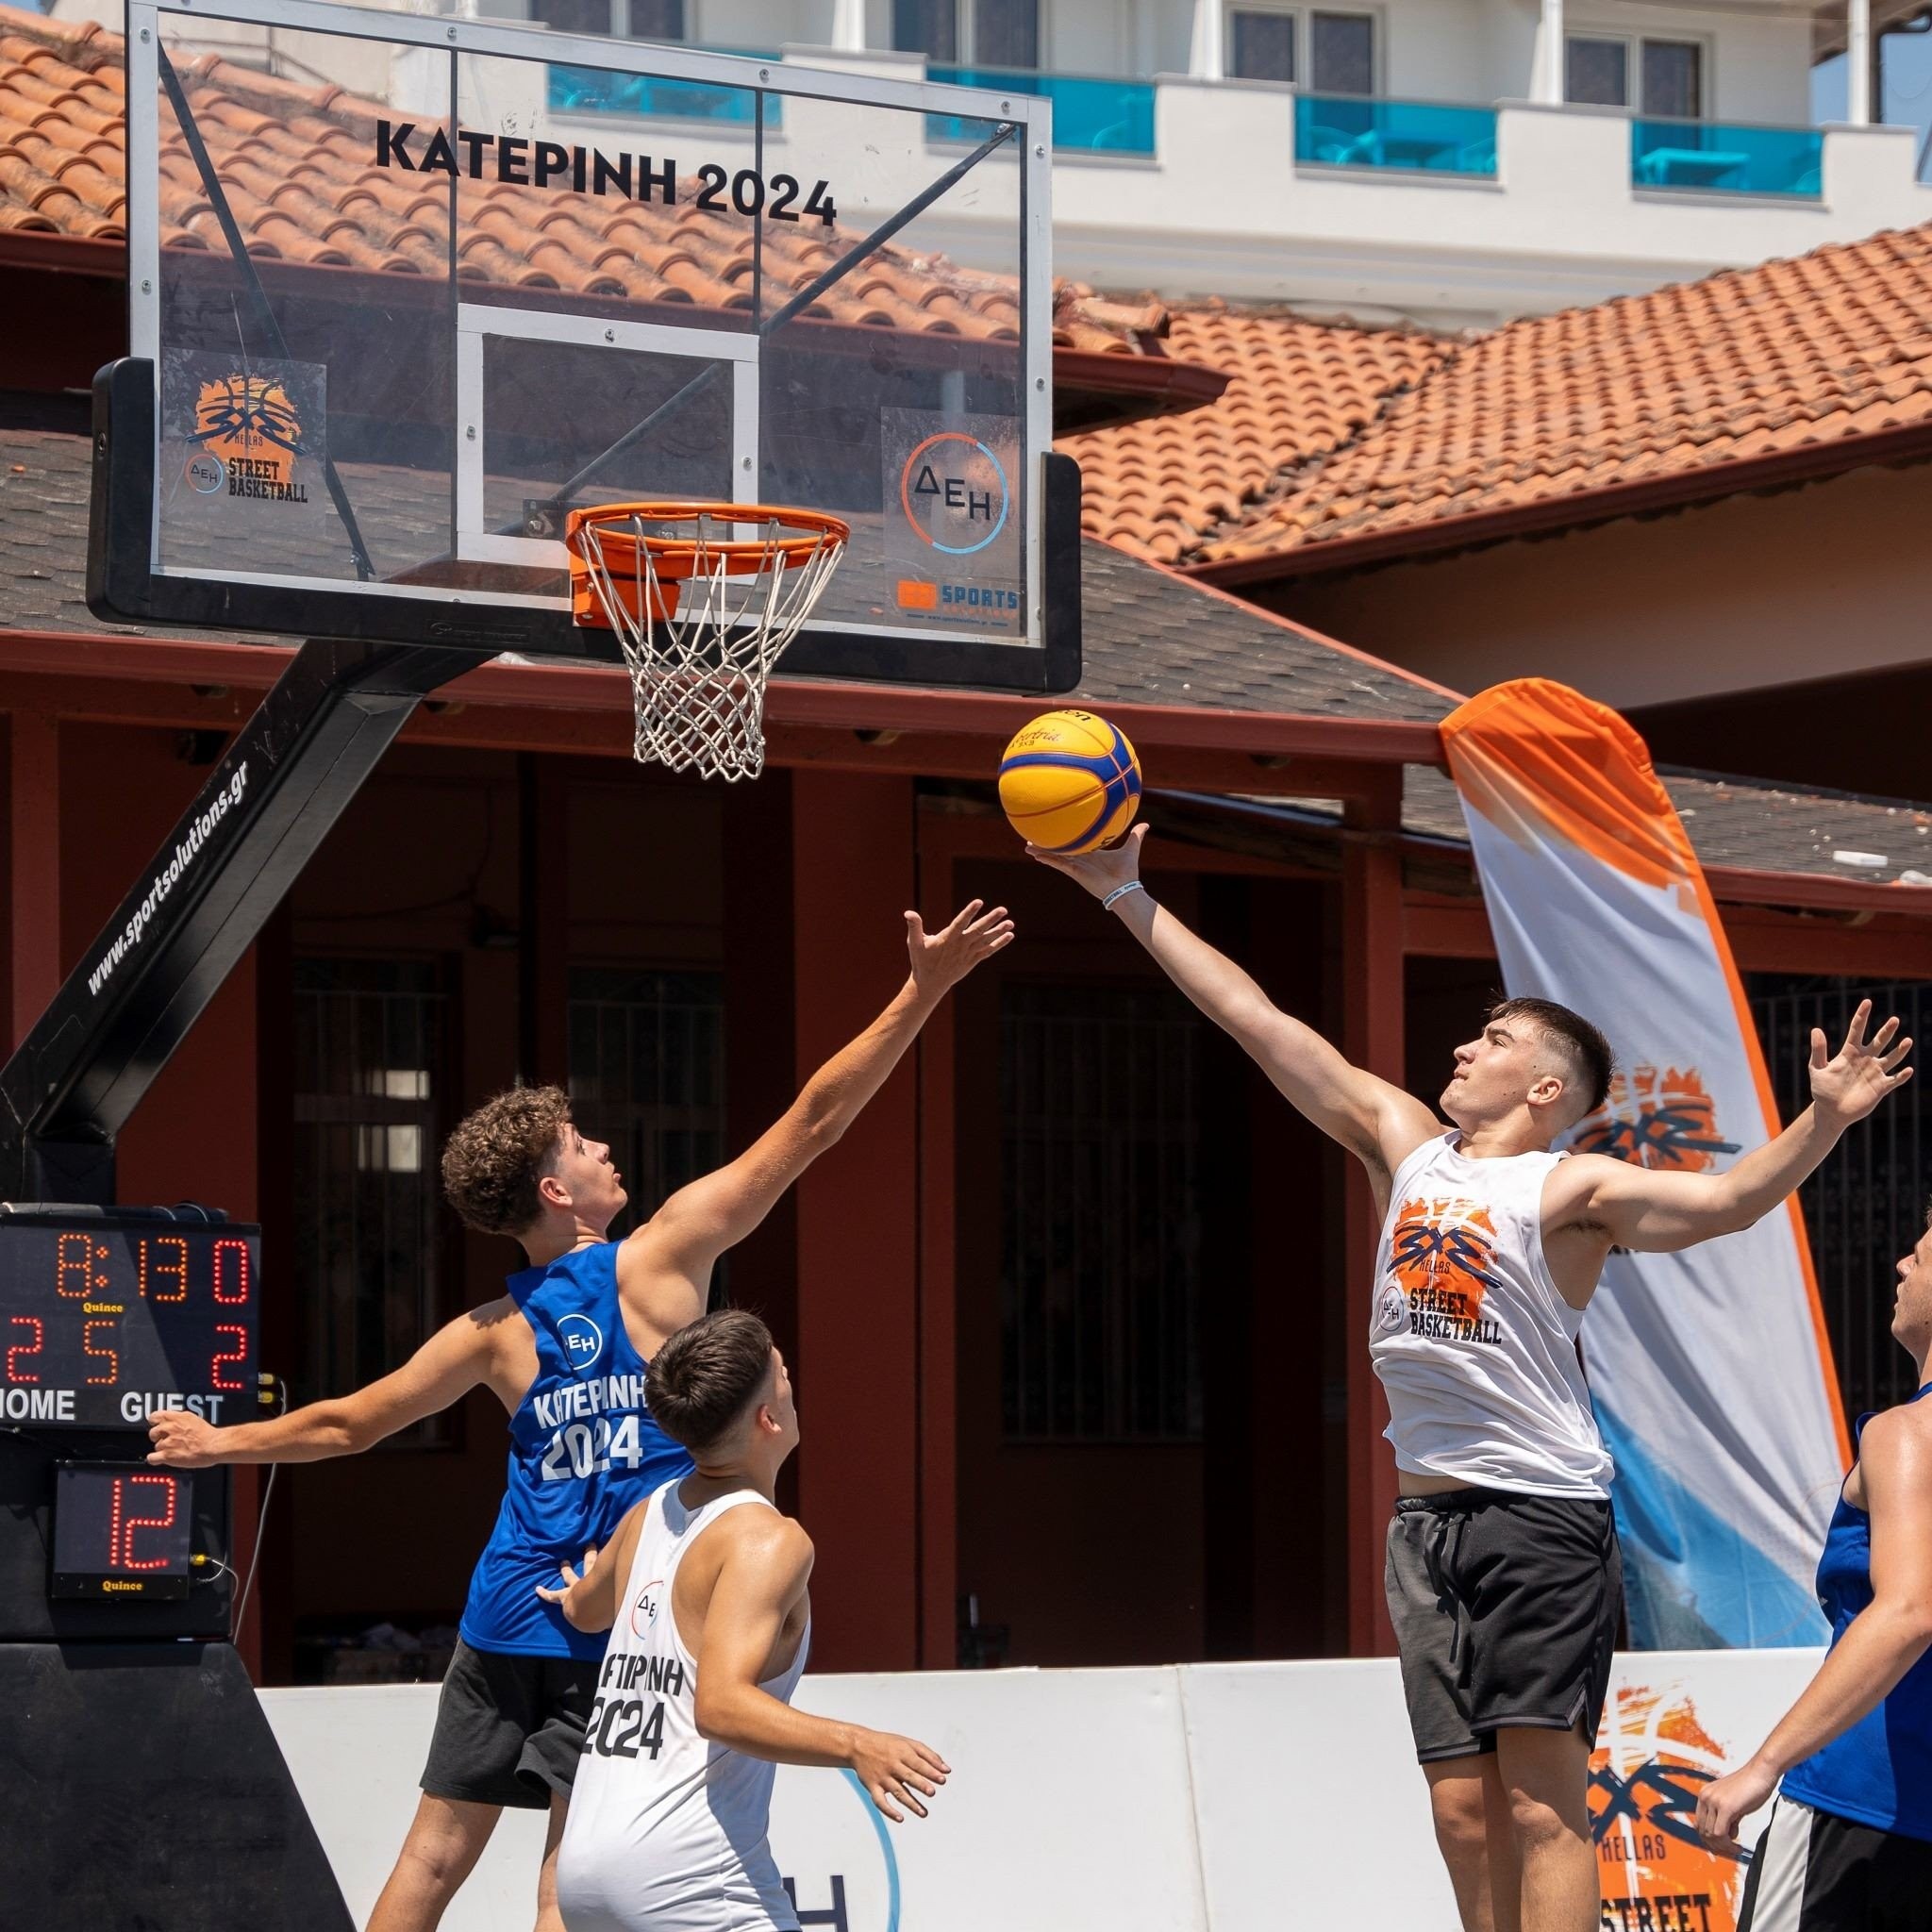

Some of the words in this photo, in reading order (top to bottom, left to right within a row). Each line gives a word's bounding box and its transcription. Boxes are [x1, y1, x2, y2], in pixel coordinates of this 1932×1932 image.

[377, 119, 676, 206] ΚΑΤΕΡΙΝΗ
[696, 163, 837, 226] 2024
[234, 434, 263, 447] HELAS
[228, 457, 280, 480] STREET
[228, 476, 308, 504] BASKETBALL
[914, 465, 991, 520] ΔΕΗ
[941, 585, 1018, 609] SPORTS
[88, 760, 247, 996] www.sportsolutions.gr
[213, 1239, 249, 1304] 0
[83, 1301, 124, 1313] Quince
[1409, 1287, 1468, 1316] STREET
[7, 1317, 43, 1383] 2
[566, 1334, 596, 1353] ΕΗ
[1408, 1311, 1503, 1345] BASKETBALL
[83, 1320, 119, 1385] 5
[211, 1324, 248, 1390] 2
[541, 1415, 643, 1481] 2024
[110, 1475, 176, 1569] 12
[102, 1580, 143, 1592] Quince
[581, 1696, 665, 1760] 2024
[1602, 1834, 1667, 1863] HELLAS
